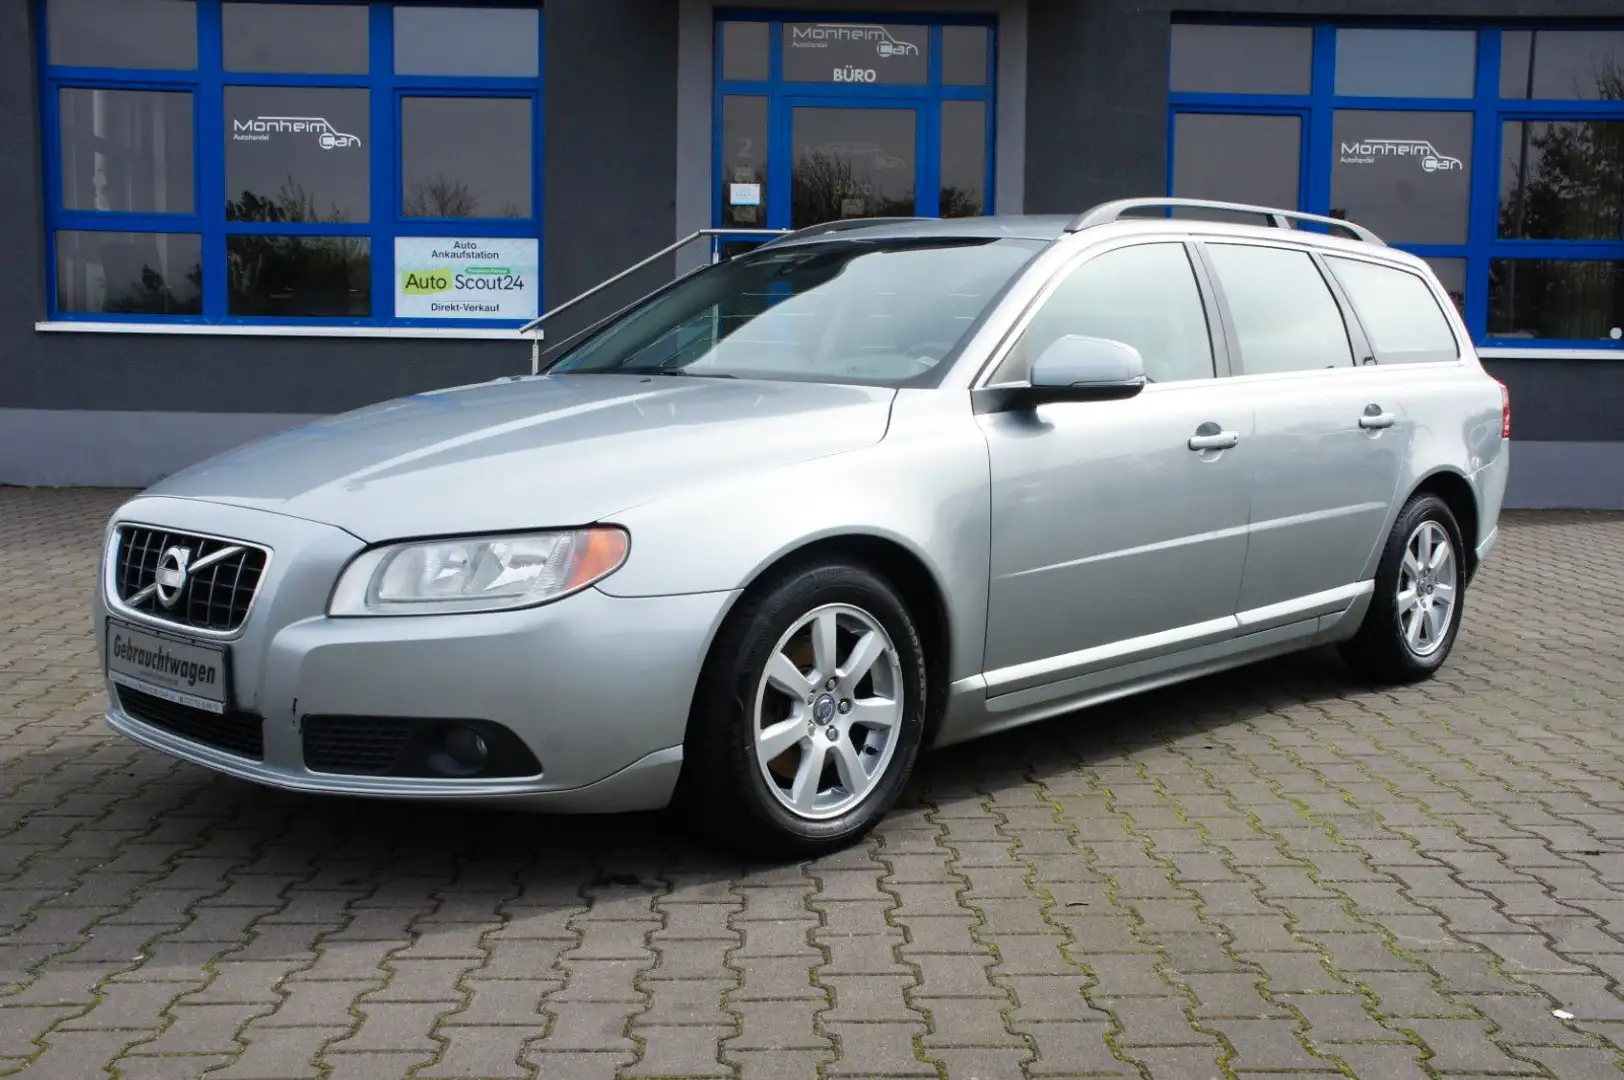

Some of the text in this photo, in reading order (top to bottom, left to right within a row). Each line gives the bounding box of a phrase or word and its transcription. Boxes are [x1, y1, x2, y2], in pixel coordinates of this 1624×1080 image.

[793, 26, 885, 40] Monheim
[833, 65, 876, 82] BÜRO
[234, 119, 326, 133] Monheim
[1341, 142, 1430, 156] Monheim
[453, 241, 477, 250] Auto
[431, 250, 500, 260] Ankaufstation
[405, 273, 524, 290] Auto Scout24
[431, 303, 500, 312] Direkt-Verkauf
[114, 634, 216, 686] Gebrauchtwagen
